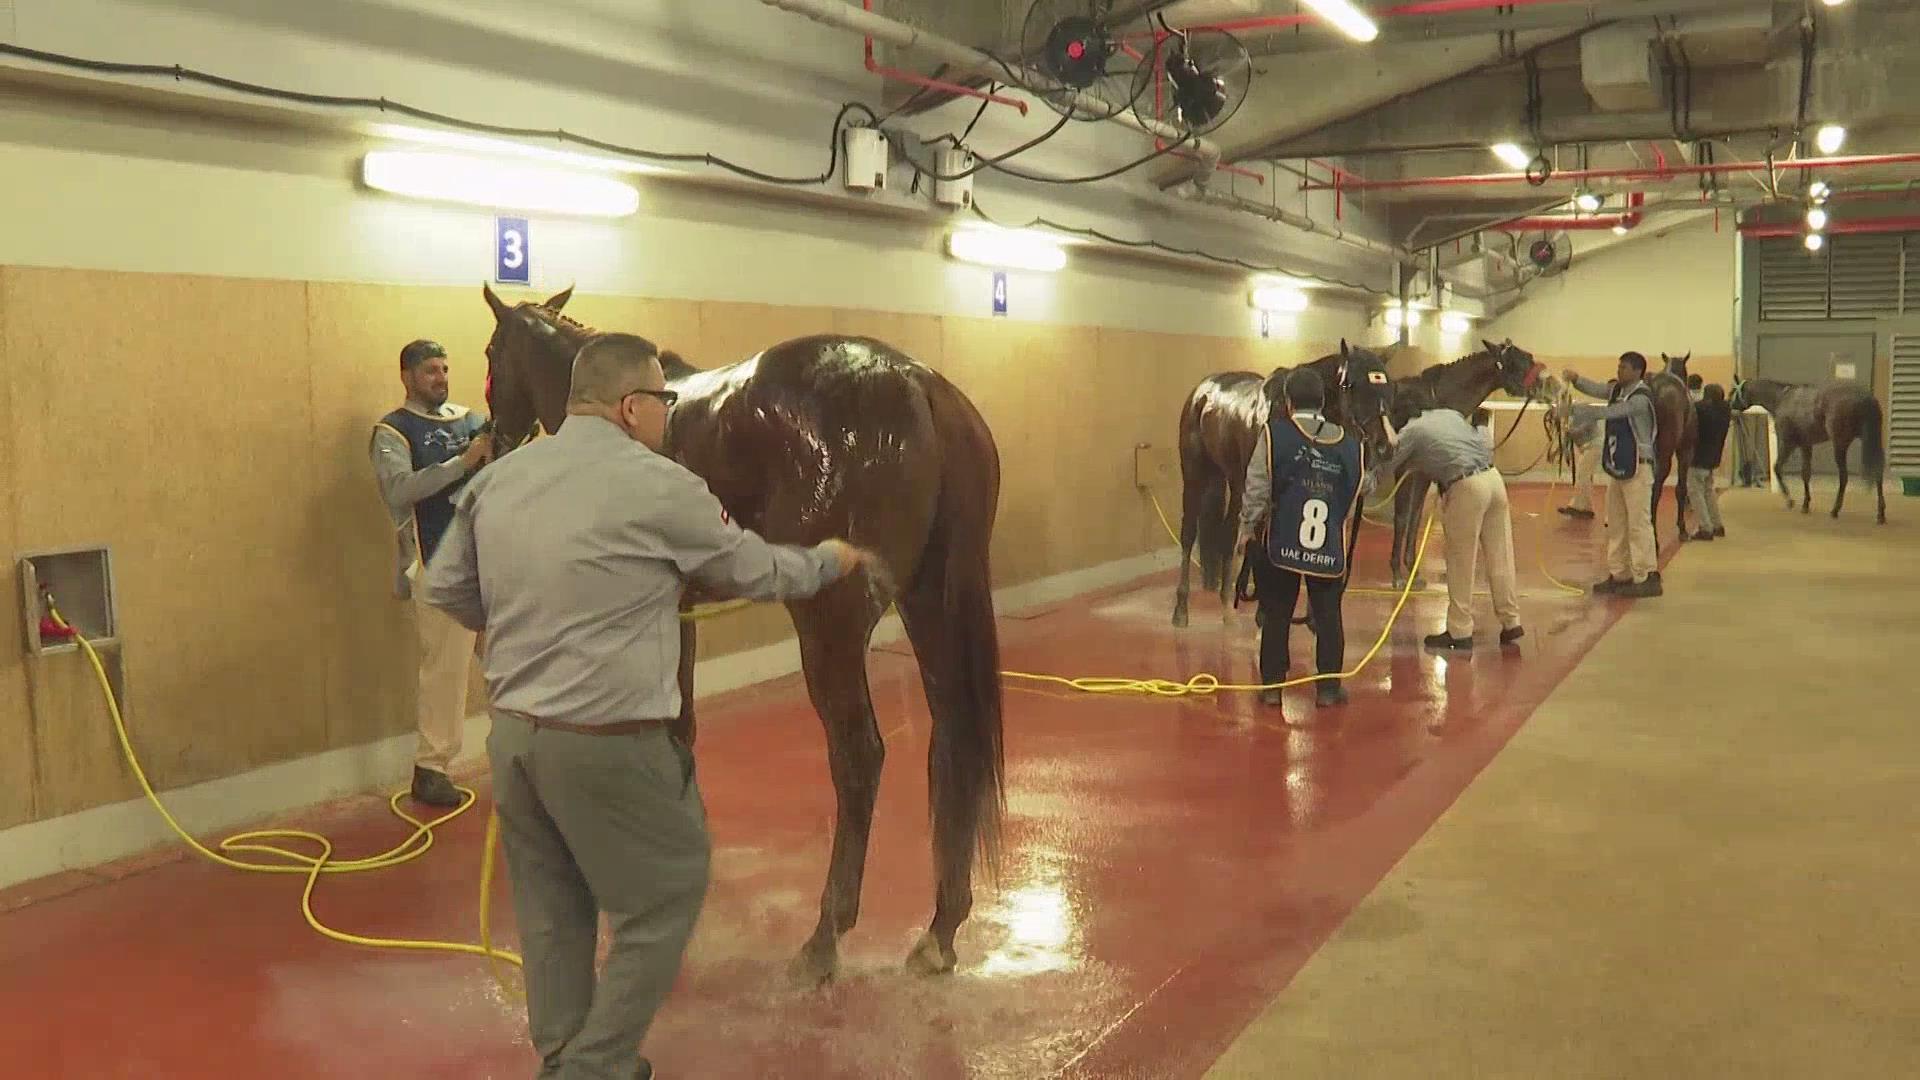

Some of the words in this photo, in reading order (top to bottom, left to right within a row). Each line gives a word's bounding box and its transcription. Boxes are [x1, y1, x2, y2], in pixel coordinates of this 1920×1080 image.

[504, 229, 523, 269] 3
[995, 279, 1005, 305] 4
[1299, 498, 1329, 550] 8
[1281, 547, 1301, 560] UAE
[1302, 552, 1336, 567] DERBY
